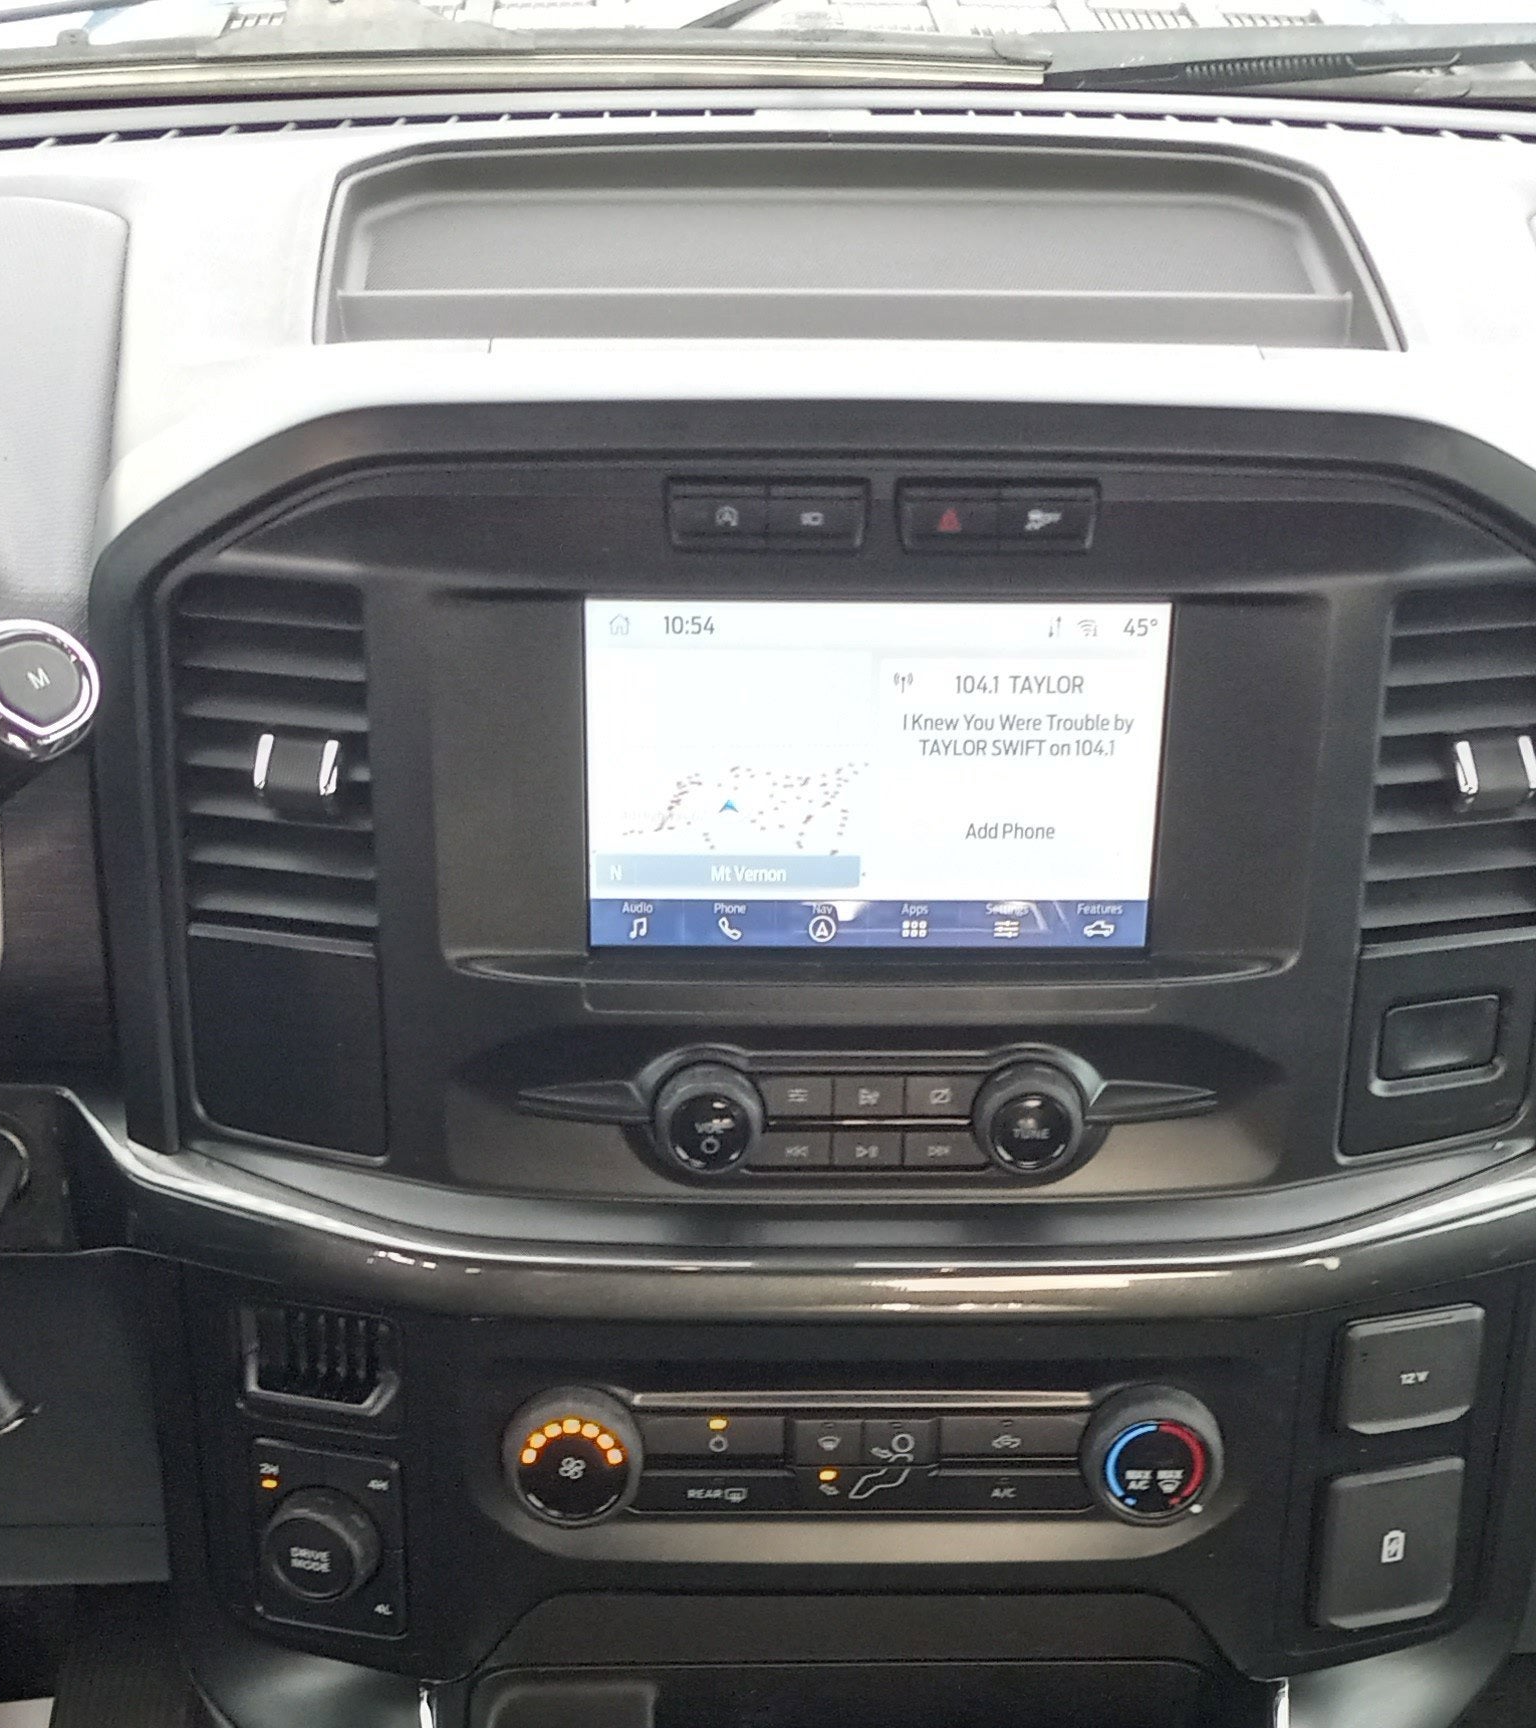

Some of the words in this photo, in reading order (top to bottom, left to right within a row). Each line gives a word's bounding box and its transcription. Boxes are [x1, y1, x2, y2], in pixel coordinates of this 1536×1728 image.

[663, 615, 715, 636] 10:54
[1123, 618, 1159, 637] 45°
[26, 669, 52, 690] M
[955, 675, 1000, 695] 104.1
[1009, 675, 1085, 695] TAYLOR
[902, 713, 908, 731] I
[911, 713, 959, 732] Knew
[963, 713, 995, 732] You
[1000, 713, 1042, 732] Were
[1047, 713, 1110, 732] Trouble
[1114, 713, 1135, 735] by
[919, 739, 986, 757] TAYLOR
[991, 739, 1046, 757] SWIFT
[1050, 743, 1071, 757] on
[1074, 739, 1115, 757] 104.1
[965, 823, 999, 840] Add
[1002, 823, 1056, 840] Phone
[710, 865, 733, 882] Mt
[735, 865, 787, 882] Vernon
[622, 902, 654, 915] Audio
[714, 902, 747, 915] Phone
[901, 903, 929, 917] Apps
[1077, 902, 1124, 915] Features
[687, 1488, 723, 1500] REAR
